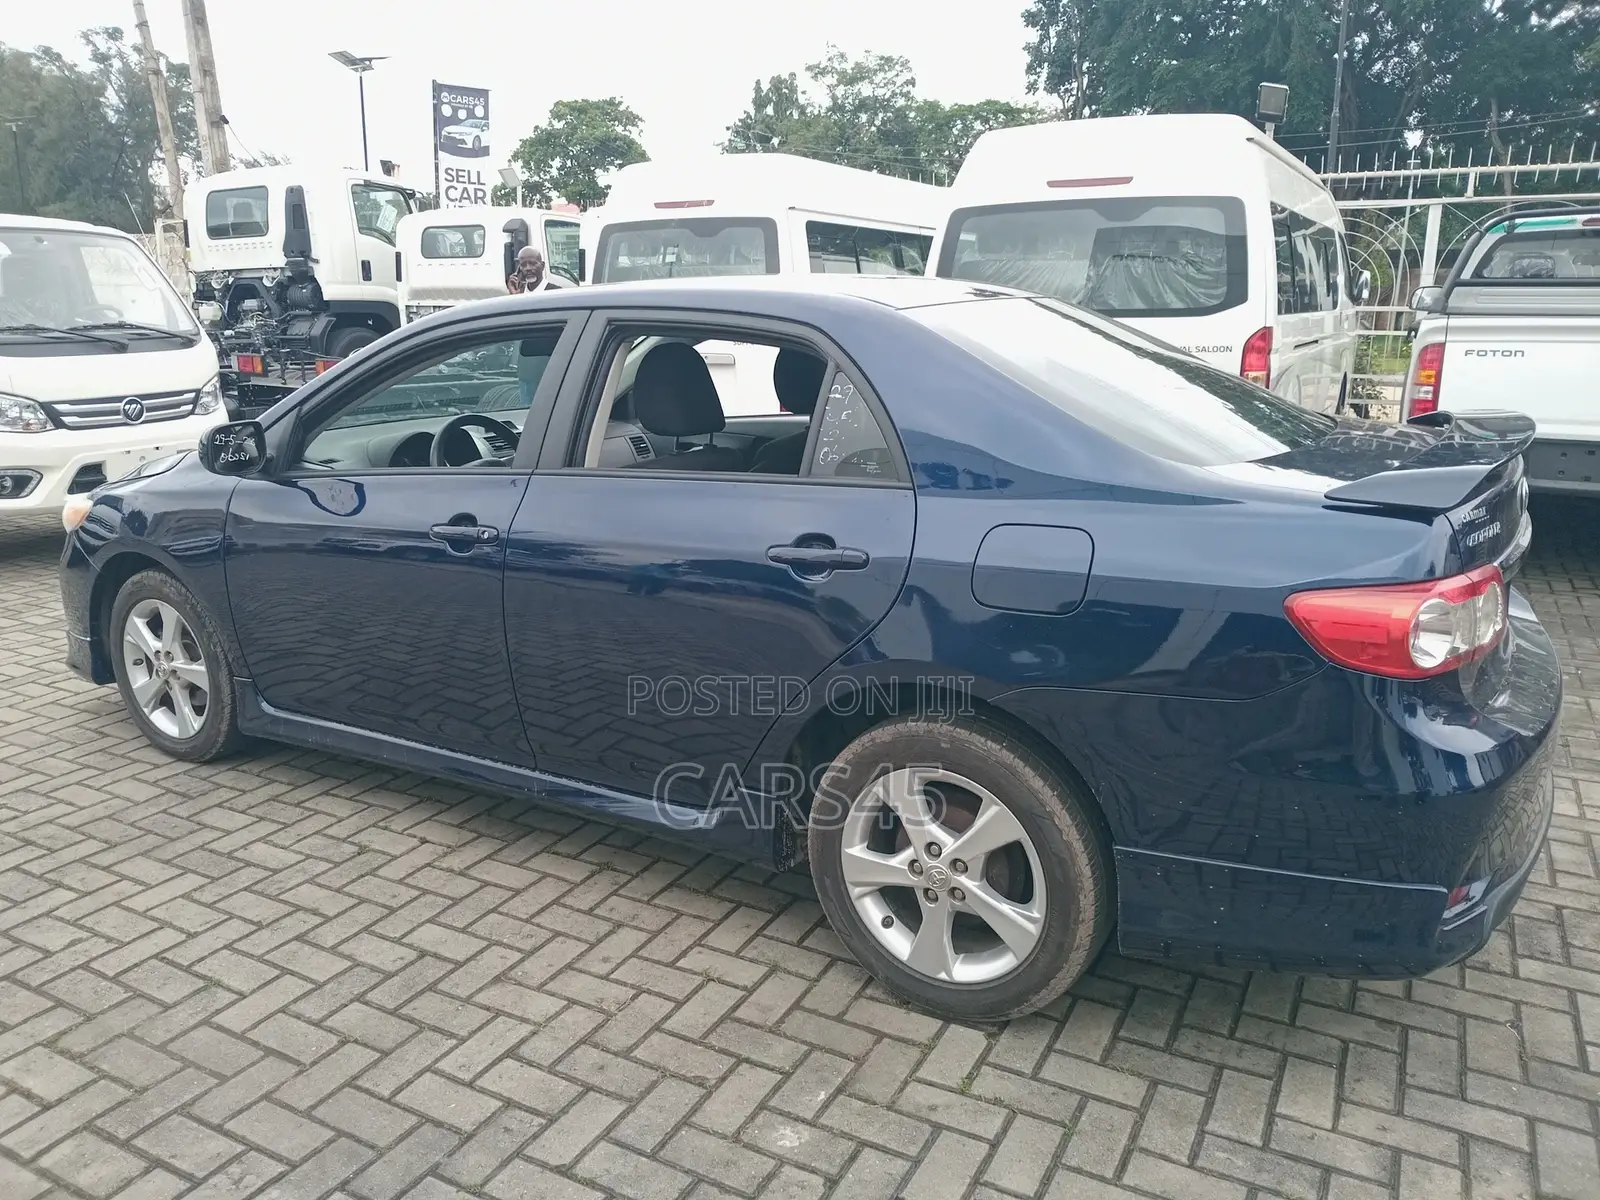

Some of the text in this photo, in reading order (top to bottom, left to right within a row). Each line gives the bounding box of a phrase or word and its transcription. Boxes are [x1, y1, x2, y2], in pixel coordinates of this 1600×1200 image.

[450, 94, 485, 106] CARS45
[444, 167, 486, 186] SELL
[445, 185, 487, 205] CAR
[1195, 345, 1233, 353] SALOON
[1464, 349, 1525, 358] FOTON
